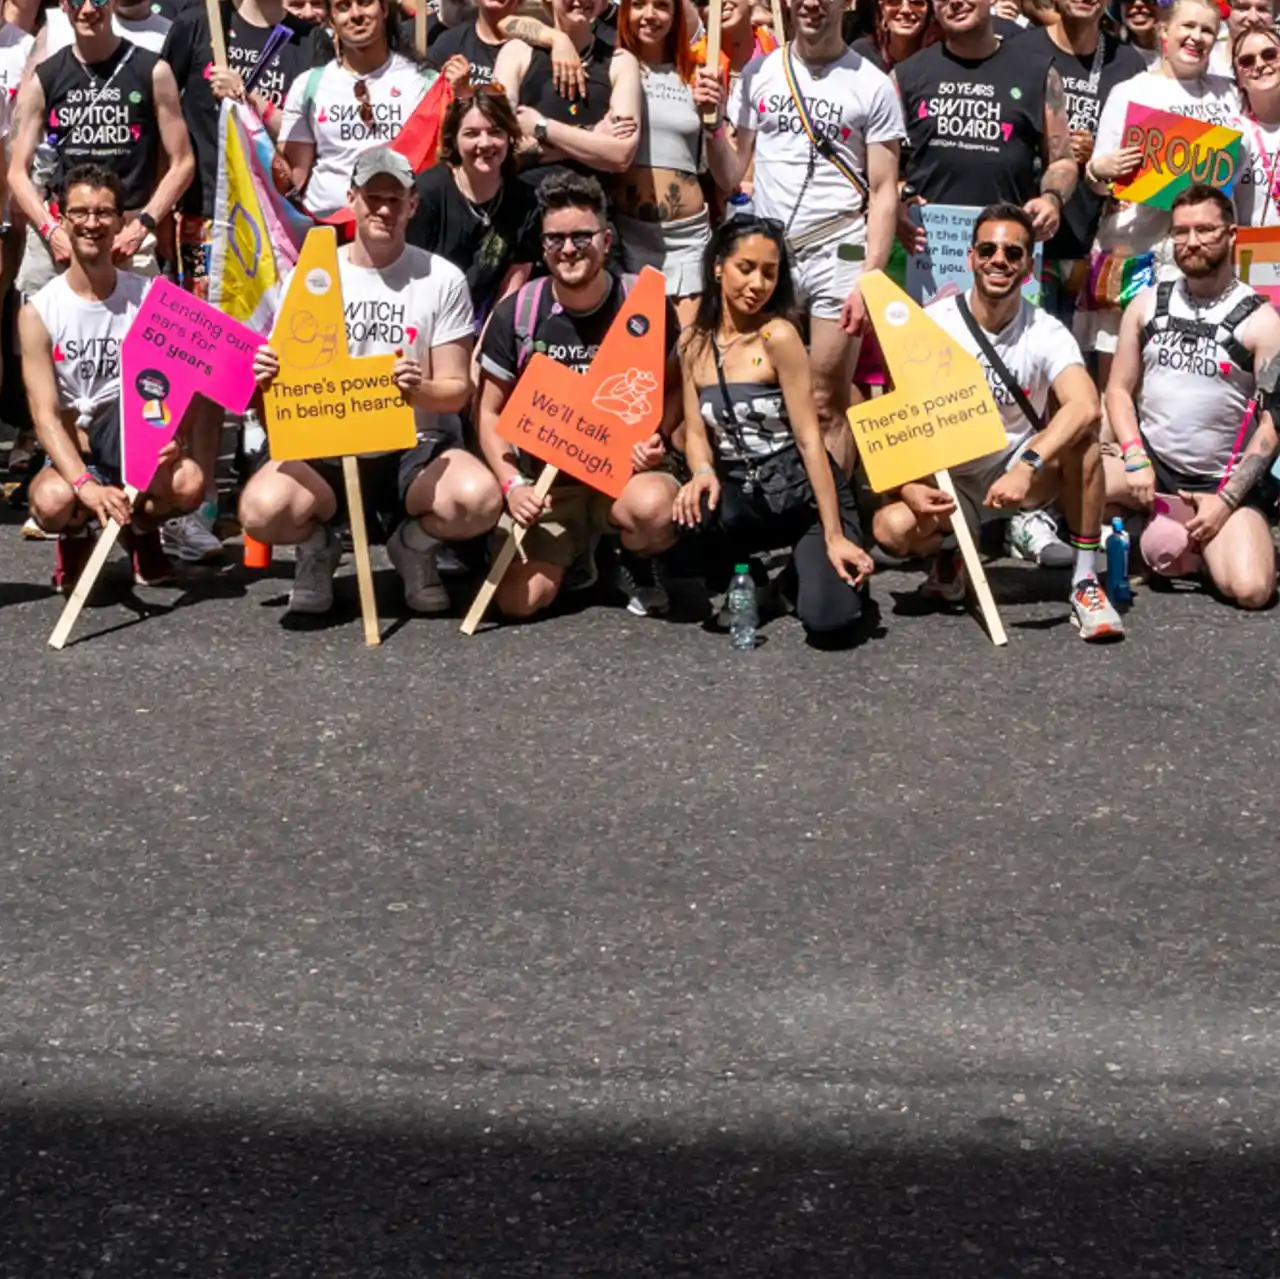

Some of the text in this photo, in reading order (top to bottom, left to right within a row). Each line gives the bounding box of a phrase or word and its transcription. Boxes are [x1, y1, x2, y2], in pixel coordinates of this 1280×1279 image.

[957, 83, 995, 98] YEARS
[59, 105, 129, 127] SWITCH
[928, 99, 1001, 121] SWITCH
[72, 124, 130, 144] BOARD
[937, 116, 1001, 140] BOARD
[1122, 125, 1234, 188] PROUD
[150, 313, 218, 353] ears for
[158, 292, 254, 353] Lending our
[141, 327, 213, 377] 50 years
[1158, 350, 1218, 377] BOARD
[272, 374, 336, 399] There's
[276, 404, 292, 421] in
[296, 401, 346, 421] being
[532, 389, 612, 446] We'll talk
[856, 384, 979, 436] There's power
[866, 402, 992, 454] in being heard.
[516, 414, 614, 479] it through.
